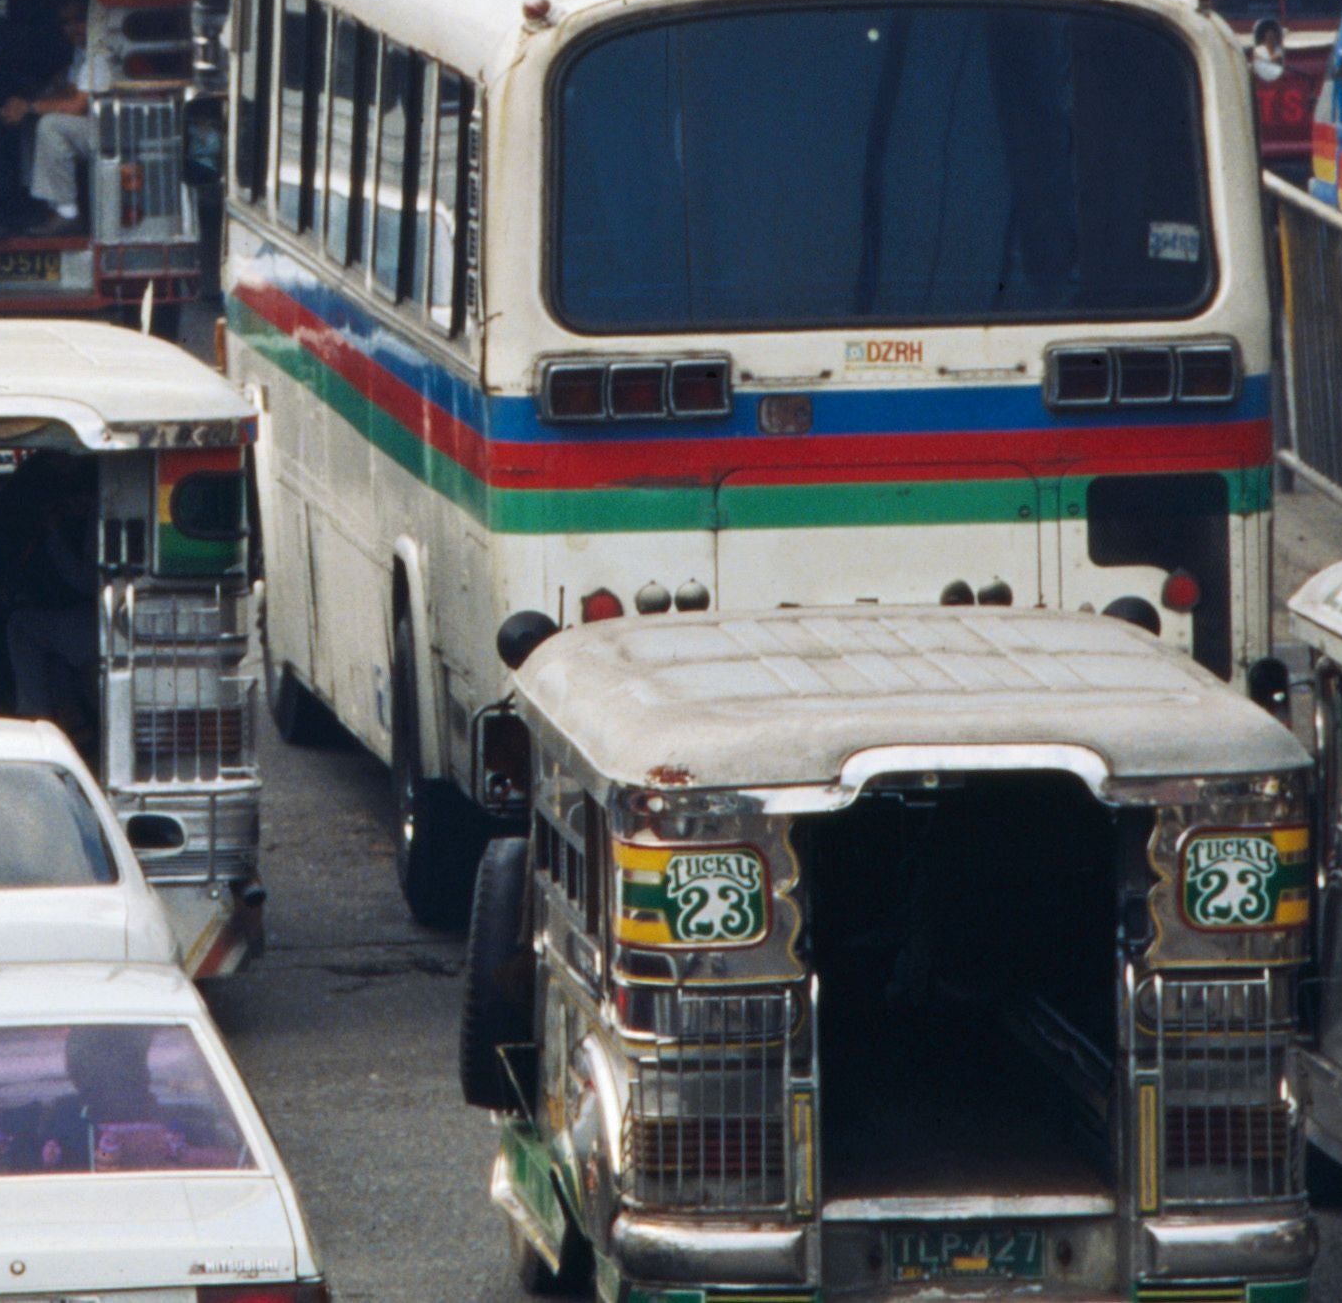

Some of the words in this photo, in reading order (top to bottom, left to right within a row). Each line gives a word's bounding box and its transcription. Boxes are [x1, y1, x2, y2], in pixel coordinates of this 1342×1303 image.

[866, 340, 924, 363] DZRH
[680, 884, 751, 938] 23
[1198, 868, 1268, 923] 23
